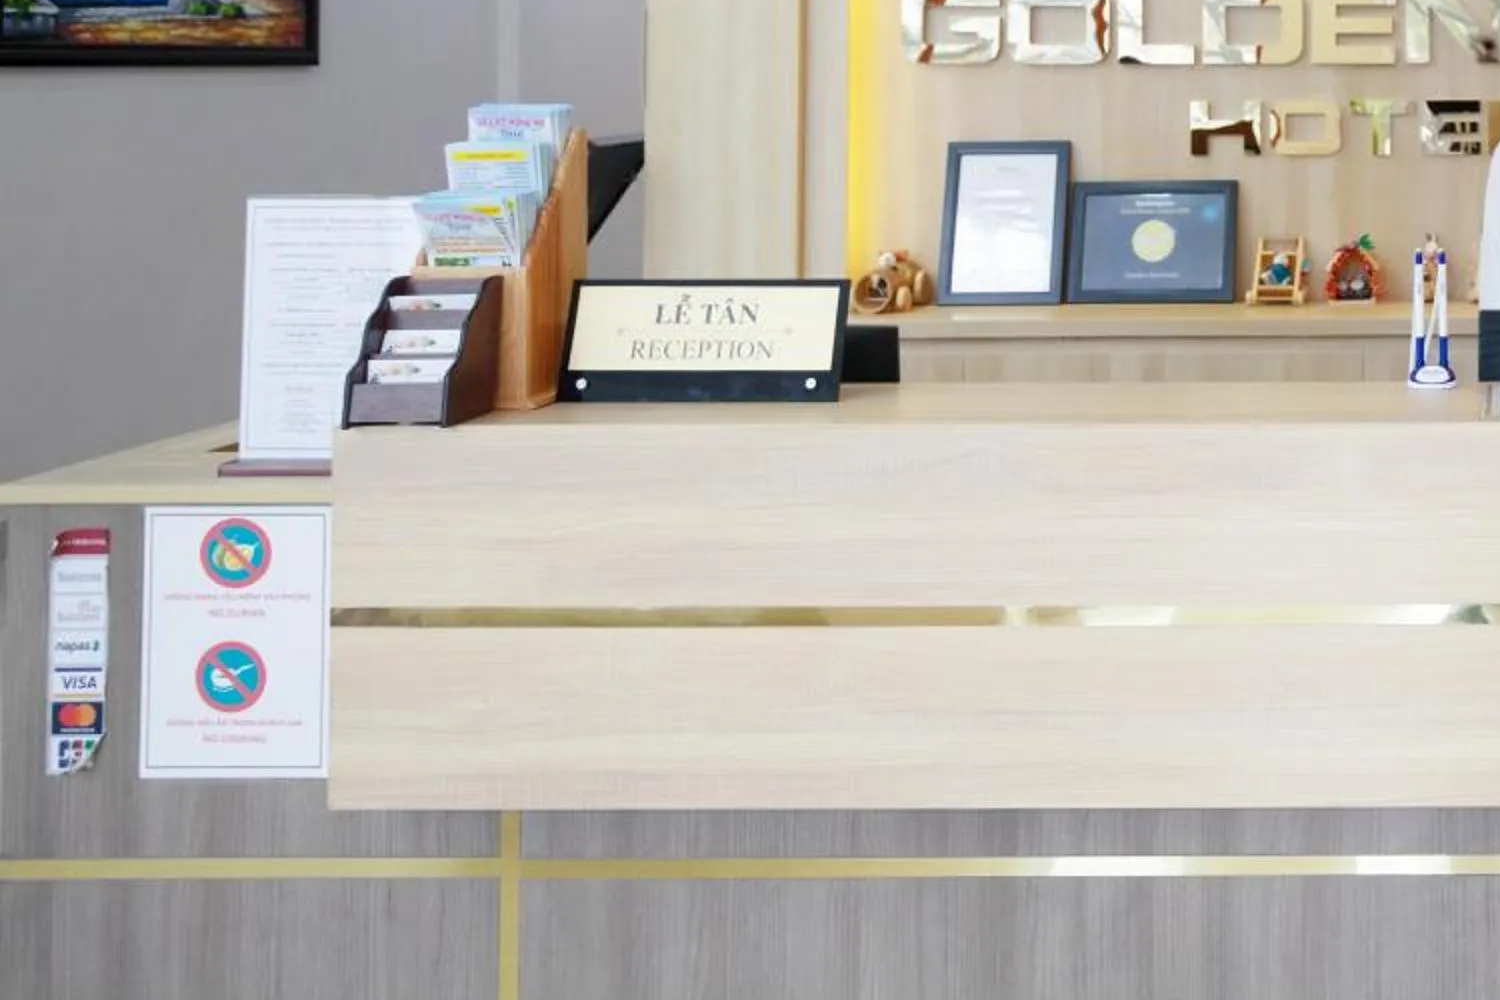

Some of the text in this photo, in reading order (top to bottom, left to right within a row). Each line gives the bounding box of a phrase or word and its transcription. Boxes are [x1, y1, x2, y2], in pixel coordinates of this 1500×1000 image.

[655, 294, 760, 326] LỄ TÂN
[629, 339, 774, 361] RECEPTION
[62, 677, 97, 689] VISA
